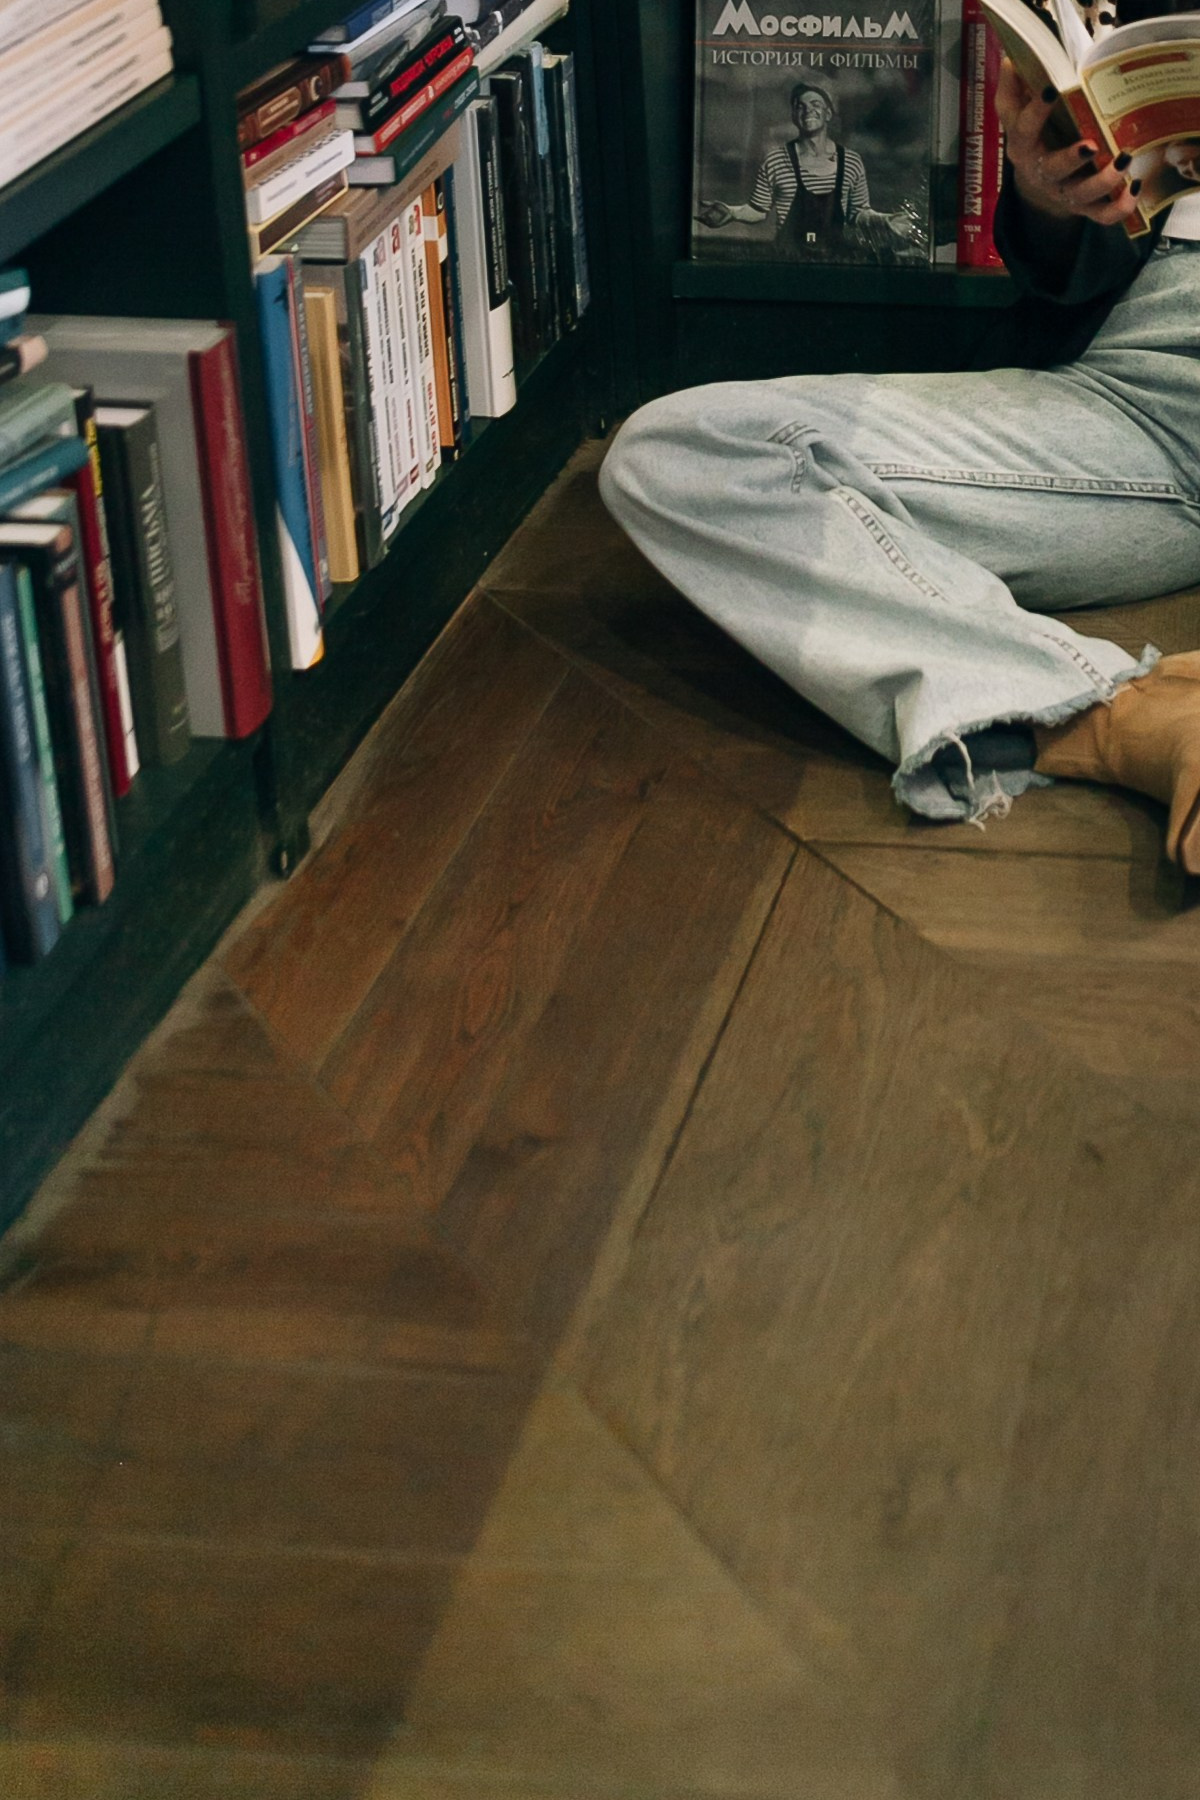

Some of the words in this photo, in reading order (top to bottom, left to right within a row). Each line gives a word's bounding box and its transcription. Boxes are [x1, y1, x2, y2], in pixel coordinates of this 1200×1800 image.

[712, 50, 803, 67] ИСТОРИЯ
[809, 52, 824, 67] И
[830, 52, 919, 70] ФИЛЬМЫ
[965, 137, 982, 216] ХРОНИКА
[964, 224, 981, 233] ТОМ
